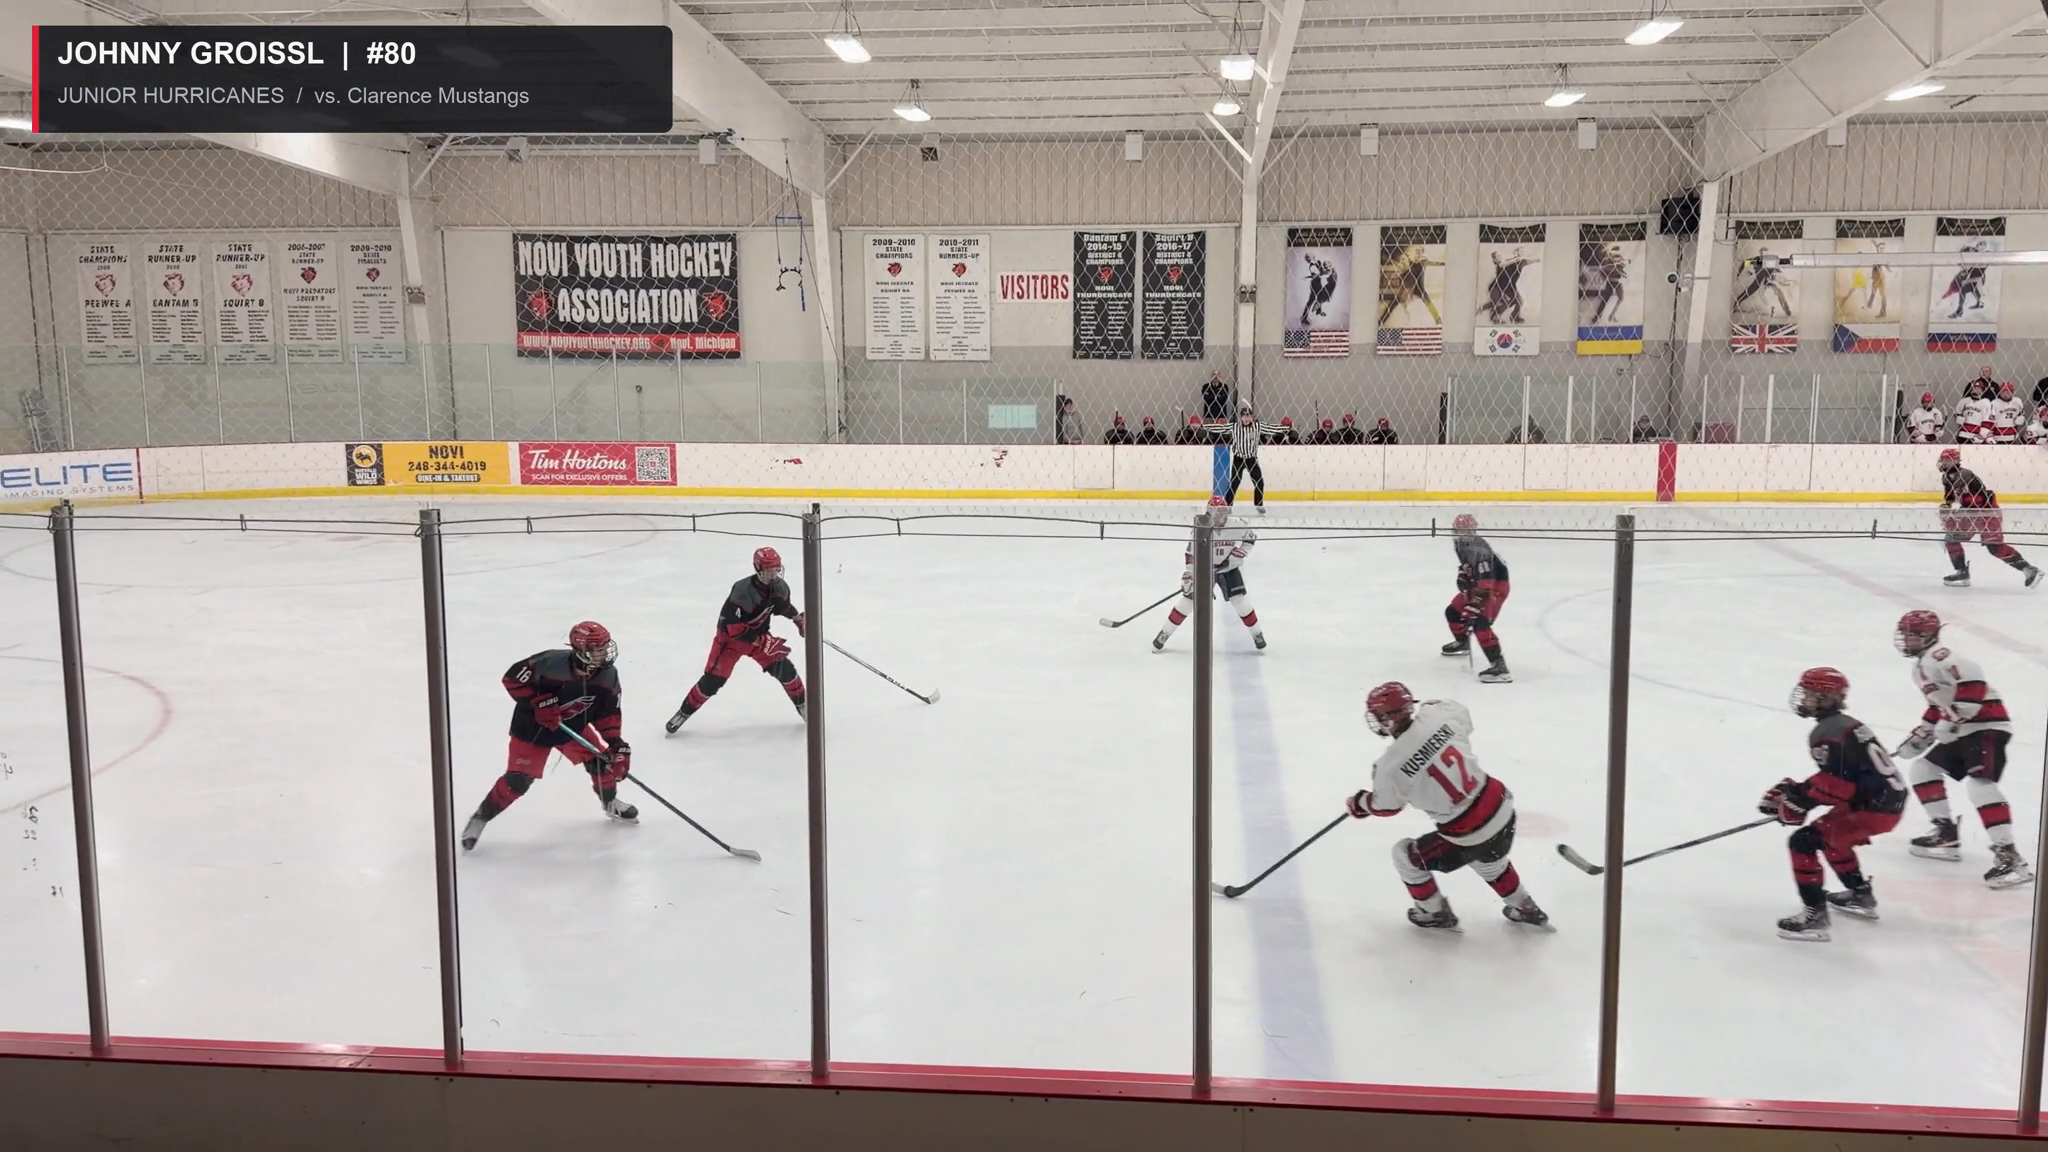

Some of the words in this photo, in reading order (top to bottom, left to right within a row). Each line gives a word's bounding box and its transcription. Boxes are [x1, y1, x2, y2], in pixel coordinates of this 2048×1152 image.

[939, 238, 979, 246] 2010-2011
[1087, 242, 1122, 251] 2014-15
[90, 245, 115, 254] STATE
[158, 244, 184, 253] STATE
[228, 243, 253, 252] STATE
[79, 255, 128, 264] CHAMPIONS
[148, 254, 197, 263] RUNNER-UP
[216, 253, 266, 263] RUNNER-UP
[518, 241, 569, 277] NOVI
[573, 242, 643, 278] YOUTH
[650, 241, 732, 278] HOCKEY
[1000, 274, 1069, 300] VISITORS
[85, 299, 120, 308] PEEWEE
[125, 299, 131, 307] A
[152, 299, 189, 308] BANTAM
[223, 299, 256, 308] SQUIRT
[557, 288, 699, 323] ASSOCIATION
[428, 445, 465, 459] NOVI
[528, 449, 559, 470] Tim
[563, 448, 627, 470] Hortons
[408, 461, 487, 471] 248-344-4019
[0, 462, 133, 489] ELITE
[355, 472, 377, 480] WILD
[450, 474, 478, 482] TAKEOUT
[4, 488, 65, 499] IMAGING
[69, 484, 135, 494] SYSTEMS
[735, 607, 742, 619] 4
[515, 666, 532, 683] 16
[1426, 745, 1479, 805] 12
